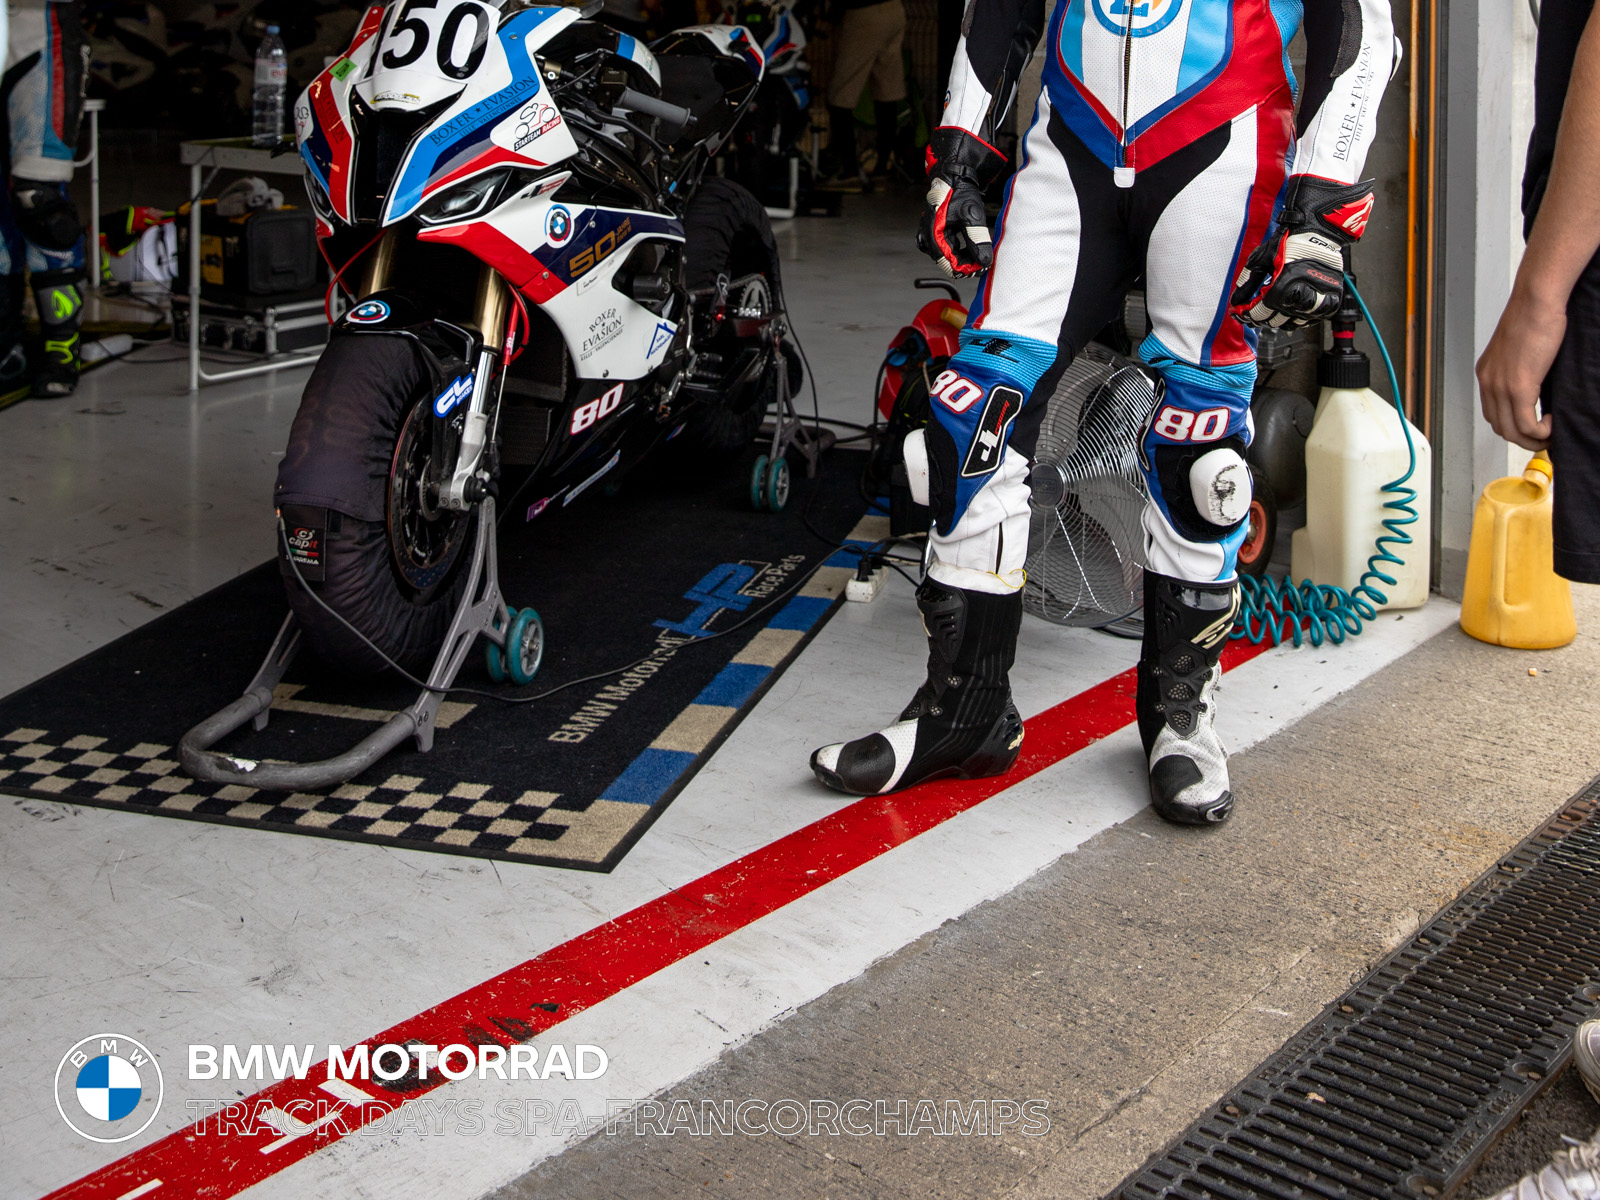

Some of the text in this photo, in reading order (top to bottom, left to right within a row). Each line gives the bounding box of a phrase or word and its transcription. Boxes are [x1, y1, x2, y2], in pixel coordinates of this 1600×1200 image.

[1351, 43, 1372, 100] EVASION
[483, 76, 535, 111] EVASION
[429, 112, 474, 145] BOXER
[515, 115, 561, 150] STARTEAM RACING
[1333, 114, 1356, 162] BOXER
[569, 230, 616, 278] 50
[583, 315, 622, 351] EVASION
[589, 308, 616, 332] BOXER
[570, 382, 624, 435] 80
[1154, 405, 1231, 443] 80
[289, 537, 318, 549] capit
[744, 554, 805, 598] Race Parts
[547, 637, 685, 743] BMW Motorrad
